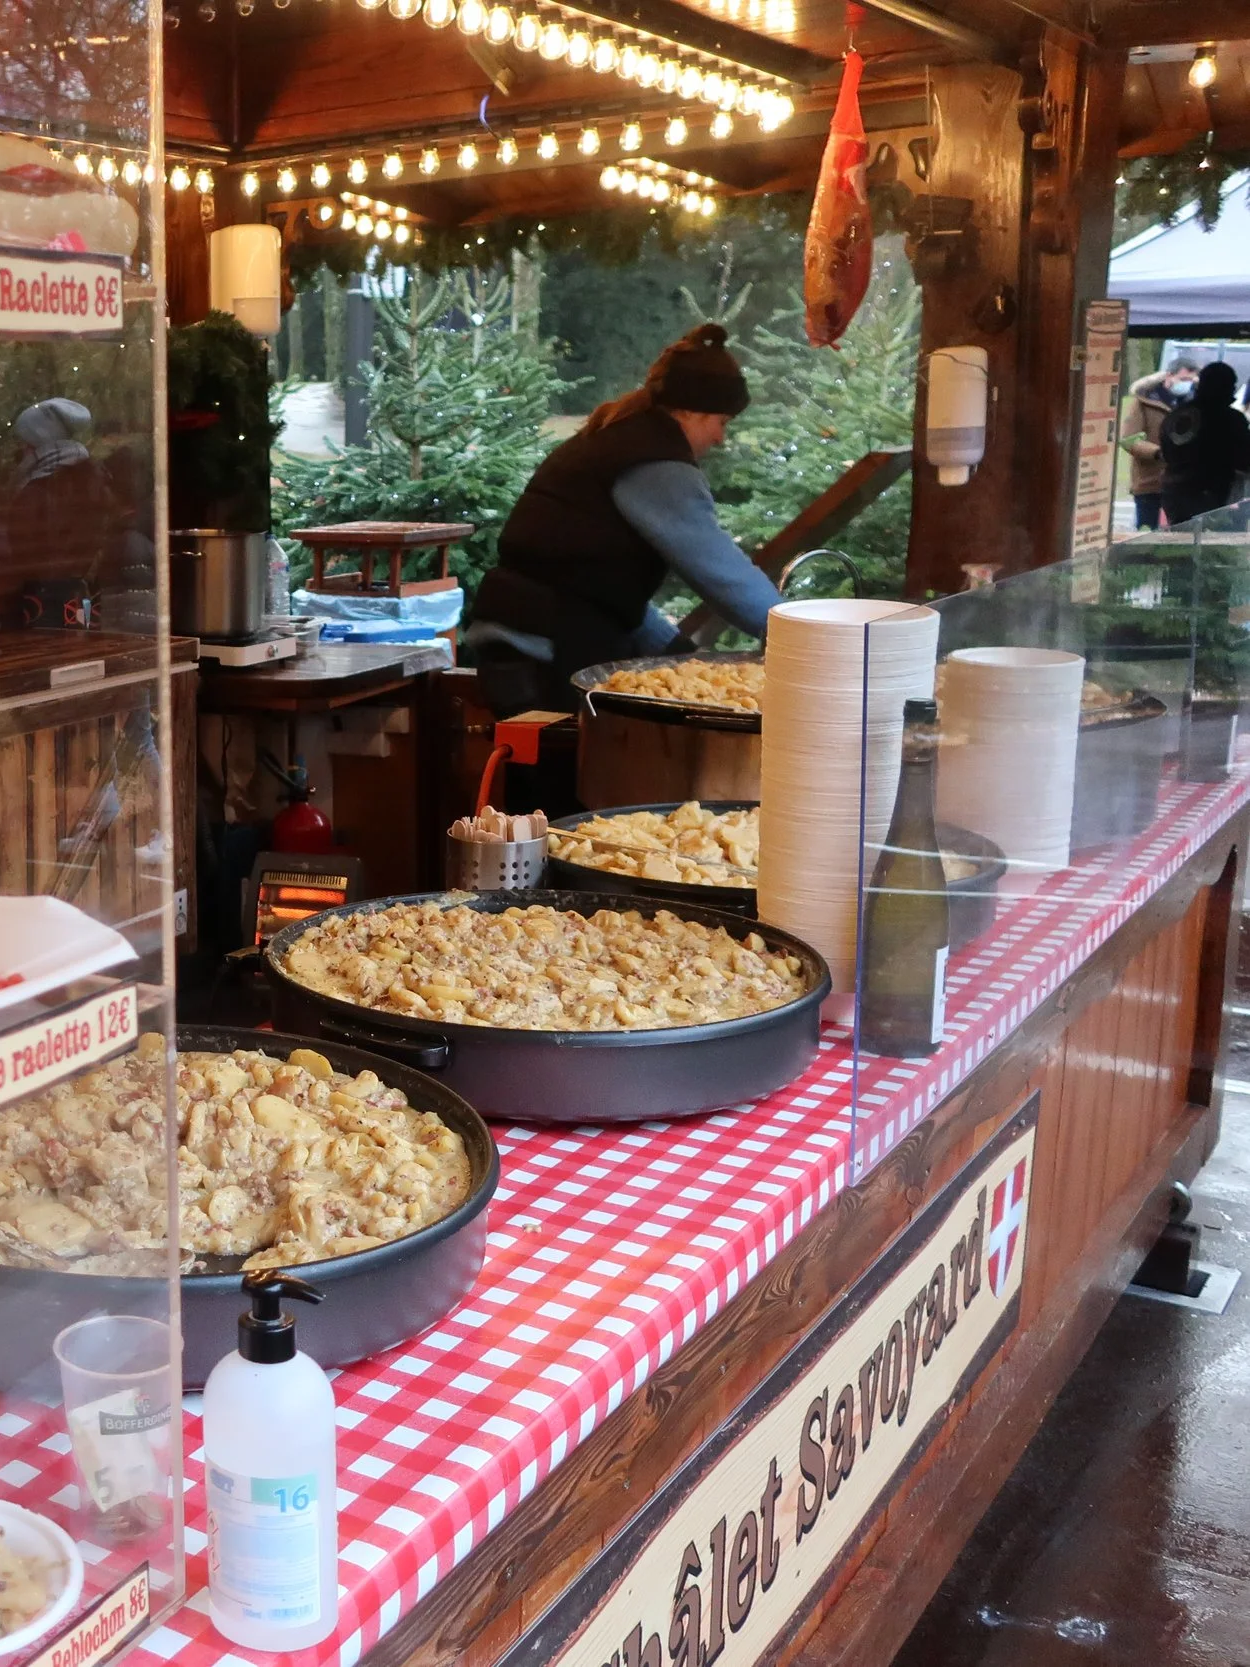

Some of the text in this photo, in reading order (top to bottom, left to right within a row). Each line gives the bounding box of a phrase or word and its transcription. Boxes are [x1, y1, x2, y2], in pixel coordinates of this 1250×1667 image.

[94, 274, 119, 319] 8€
[11, 1018, 91, 1082] raclette
[98, 996, 131, 1044] 12€
[795, 1185, 989, 1546] Savoyard
[274, 1484, 310, 1513] 16
[129, 1578, 147, 1619] 8€
